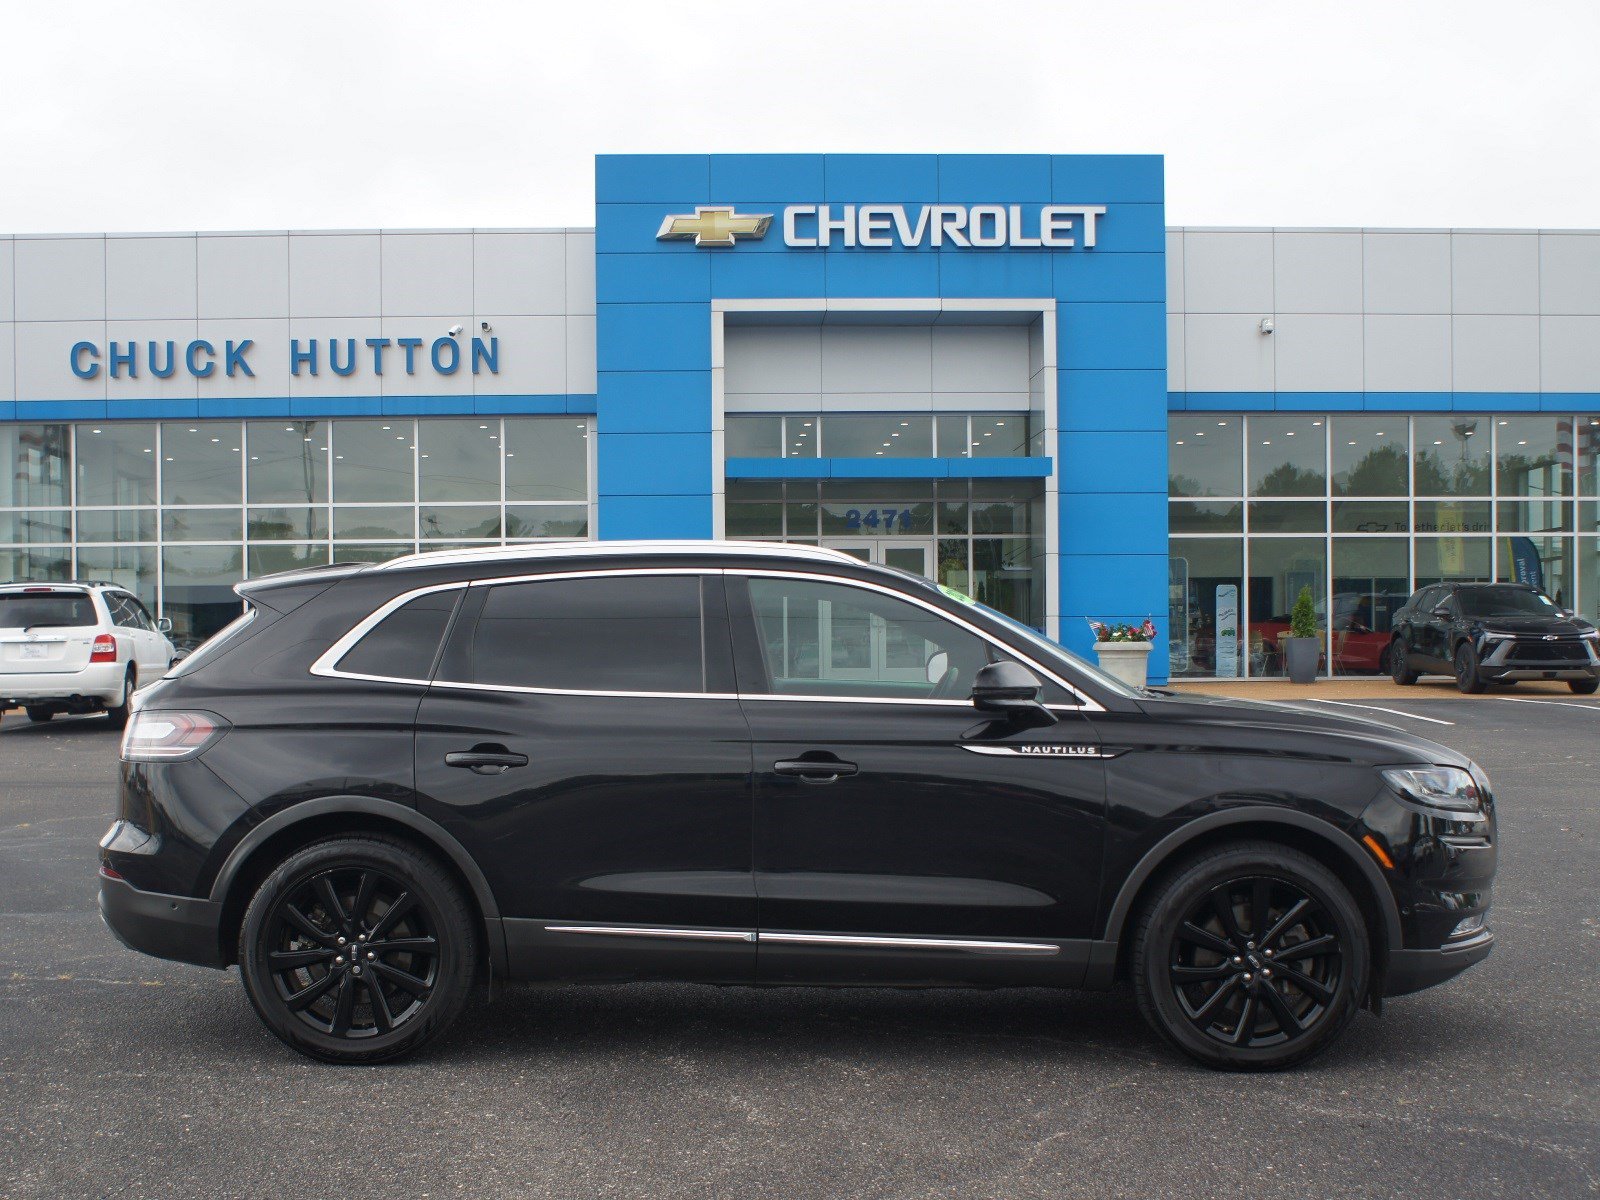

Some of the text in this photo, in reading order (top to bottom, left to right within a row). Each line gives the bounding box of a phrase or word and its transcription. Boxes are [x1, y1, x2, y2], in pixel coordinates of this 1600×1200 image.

[783, 205, 1107, 248] CHEVROLET
[70, 336, 500, 379] CHUCK HUTTON
[845, 509, 911, 528] 2471
[1395, 522, 1444, 532] Toether
[1021, 746, 1096, 754] NAUTILUS
